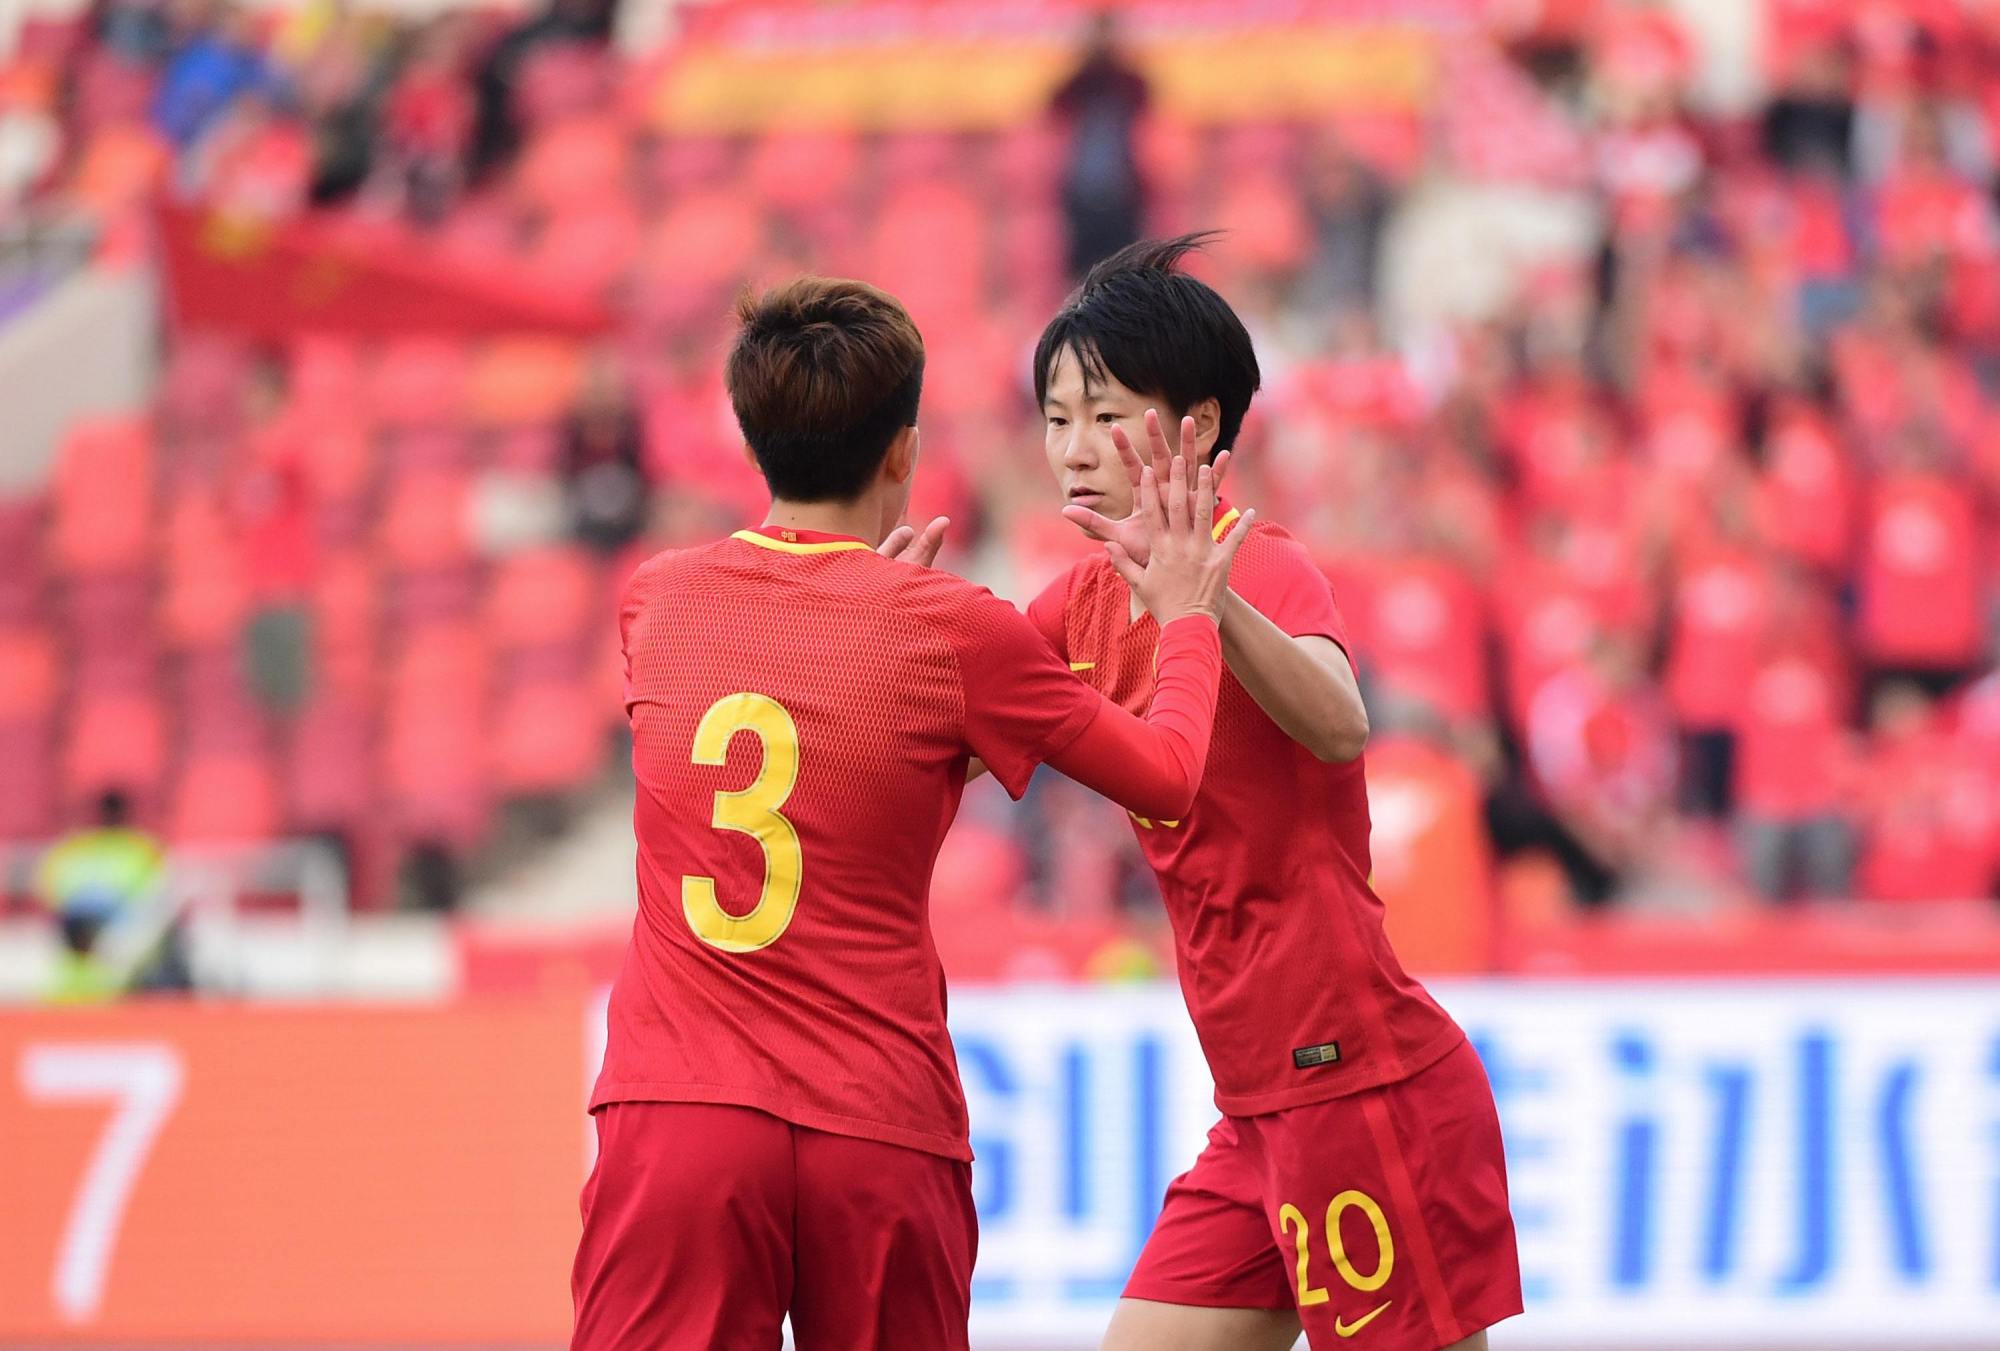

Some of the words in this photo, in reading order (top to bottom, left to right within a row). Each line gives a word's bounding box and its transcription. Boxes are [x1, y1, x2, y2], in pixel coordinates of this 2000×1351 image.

[682, 692, 802, 953] 3
[20, 1043, 184, 1321] 7
[1279, 1189, 1395, 1306] 20
